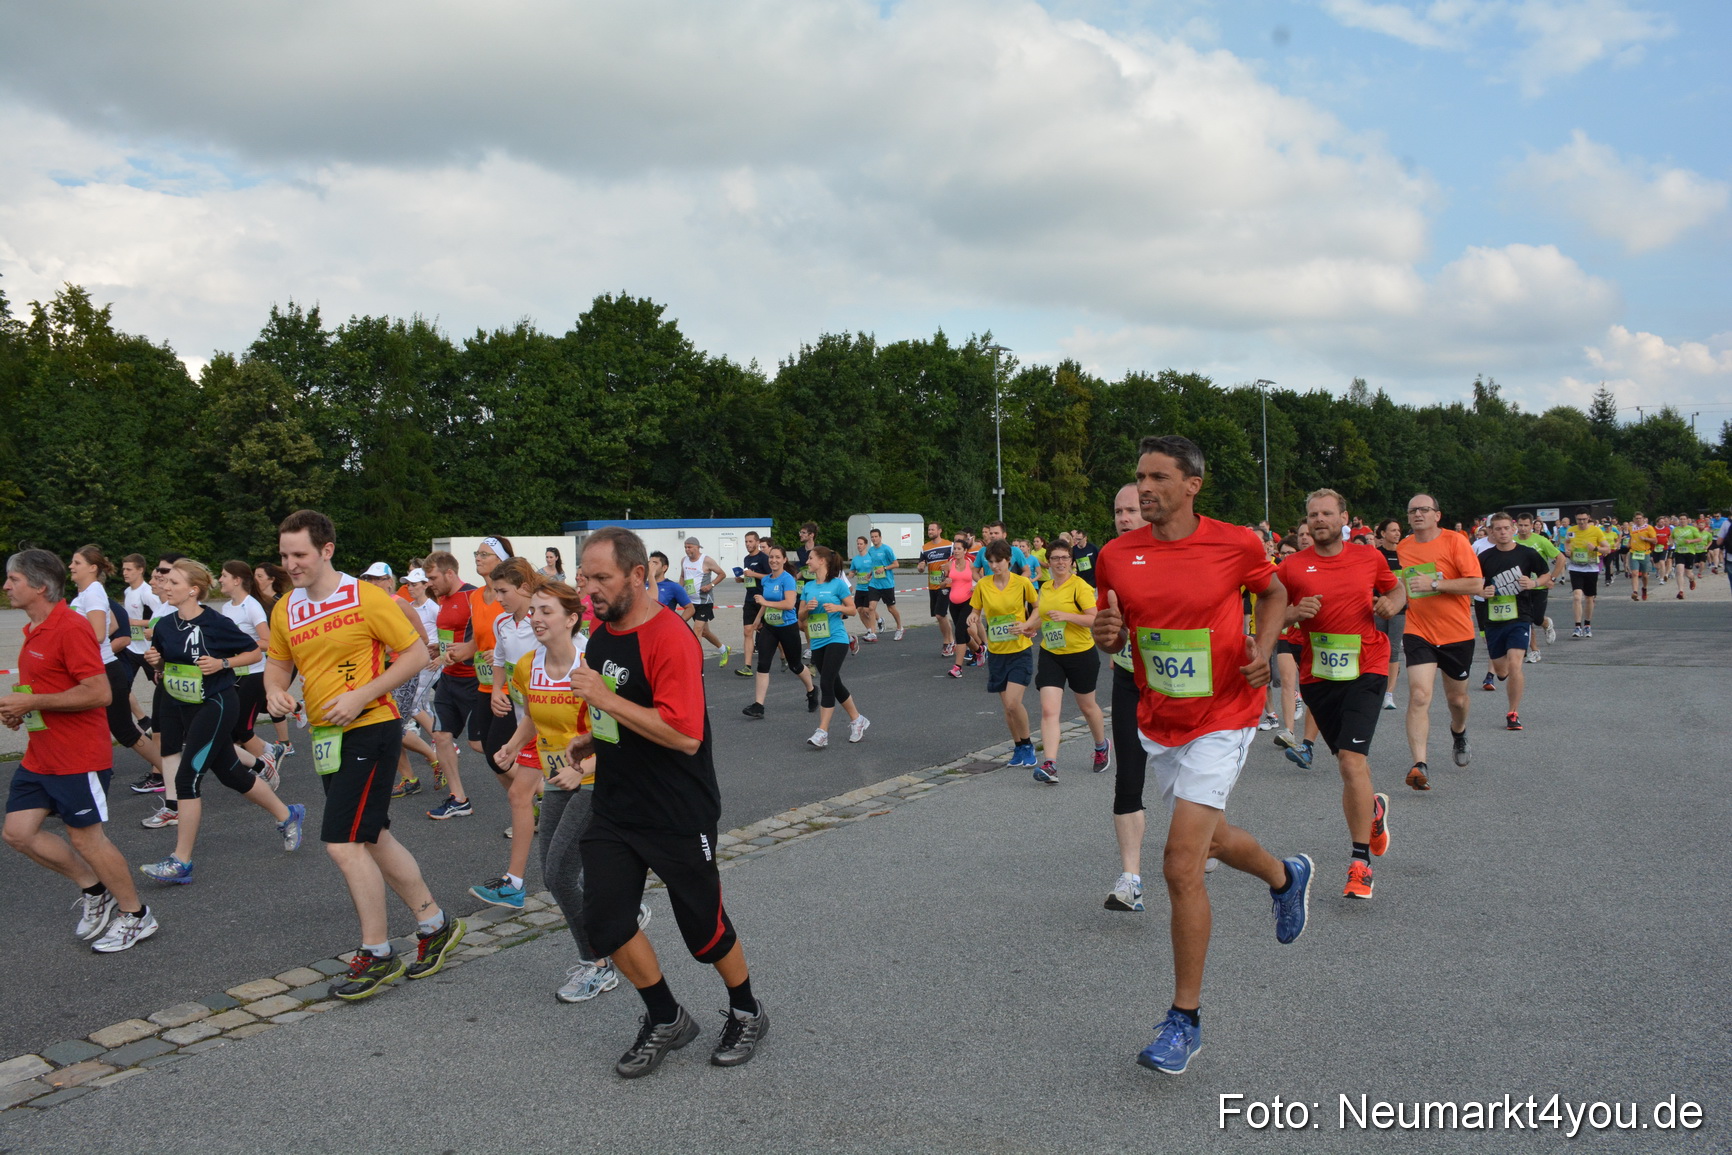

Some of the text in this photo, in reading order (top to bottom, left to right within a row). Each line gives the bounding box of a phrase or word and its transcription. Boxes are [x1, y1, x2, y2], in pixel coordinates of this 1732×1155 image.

[1493, 604, 1512, 614] 975
[290, 612, 365, 648] MAX BÖGL
[809, 622, 827, 632] 1091
[1045, 630, 1063, 642] 1285
[1320, 651, 1350, 668] 965
[1152, 655, 1196, 679] 964
[167, 678, 196, 694] 1151
[528, 693, 580, 705] MAX BÖGL
